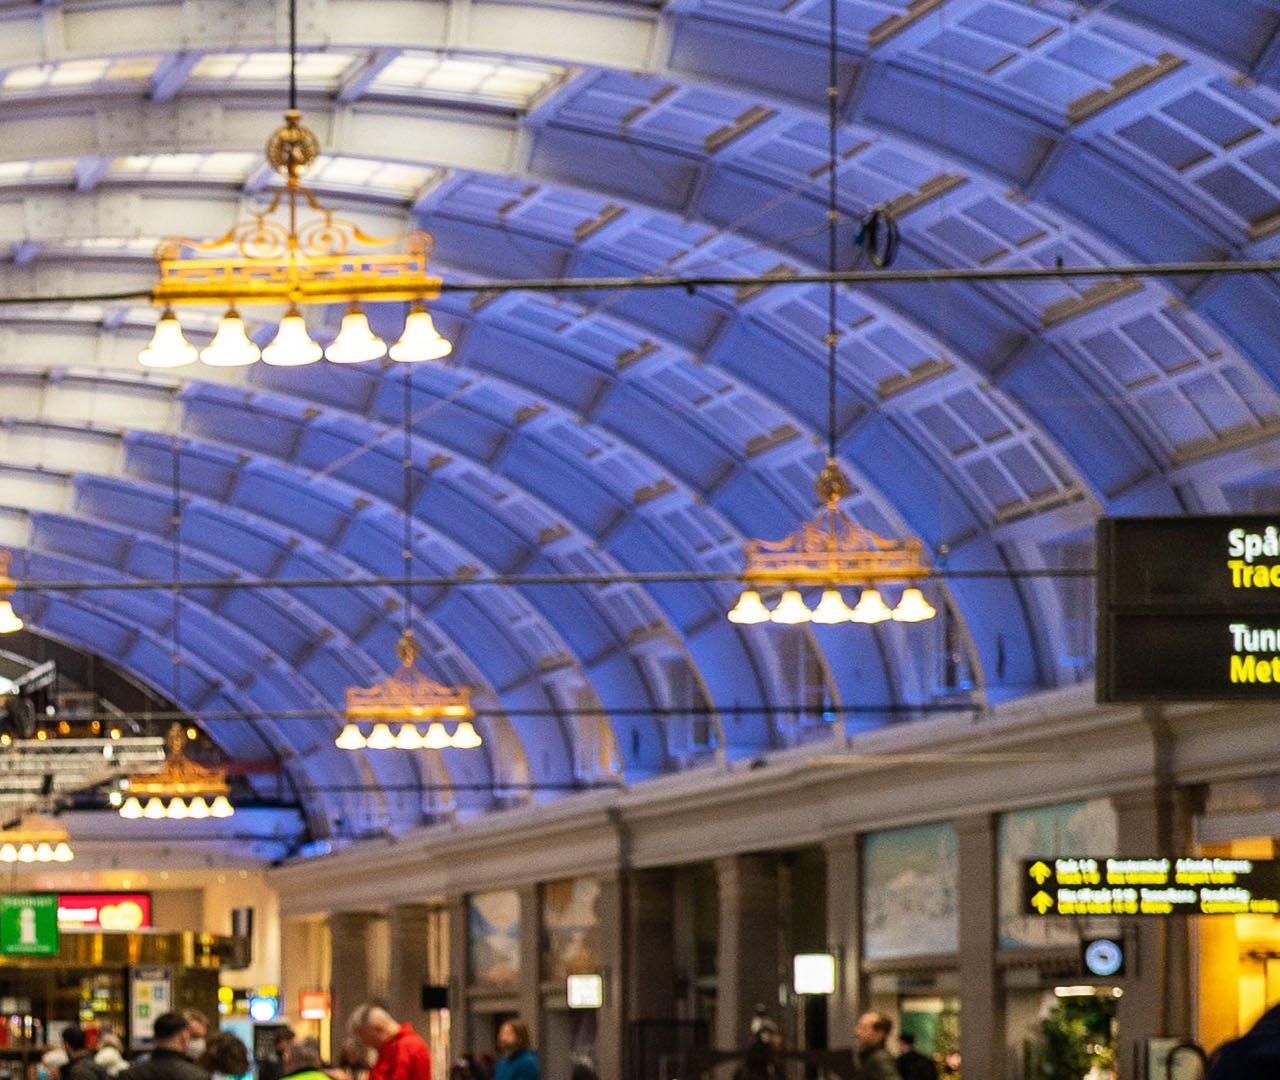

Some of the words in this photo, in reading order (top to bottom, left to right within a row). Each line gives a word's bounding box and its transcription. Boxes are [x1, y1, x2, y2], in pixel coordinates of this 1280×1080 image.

[1228, 526, 1280, 563] Spå
[1227, 559, 1280, 588] Trac
[1229, 623, 1280, 652] Tun
[1230, 654, 1280, 683] Met
